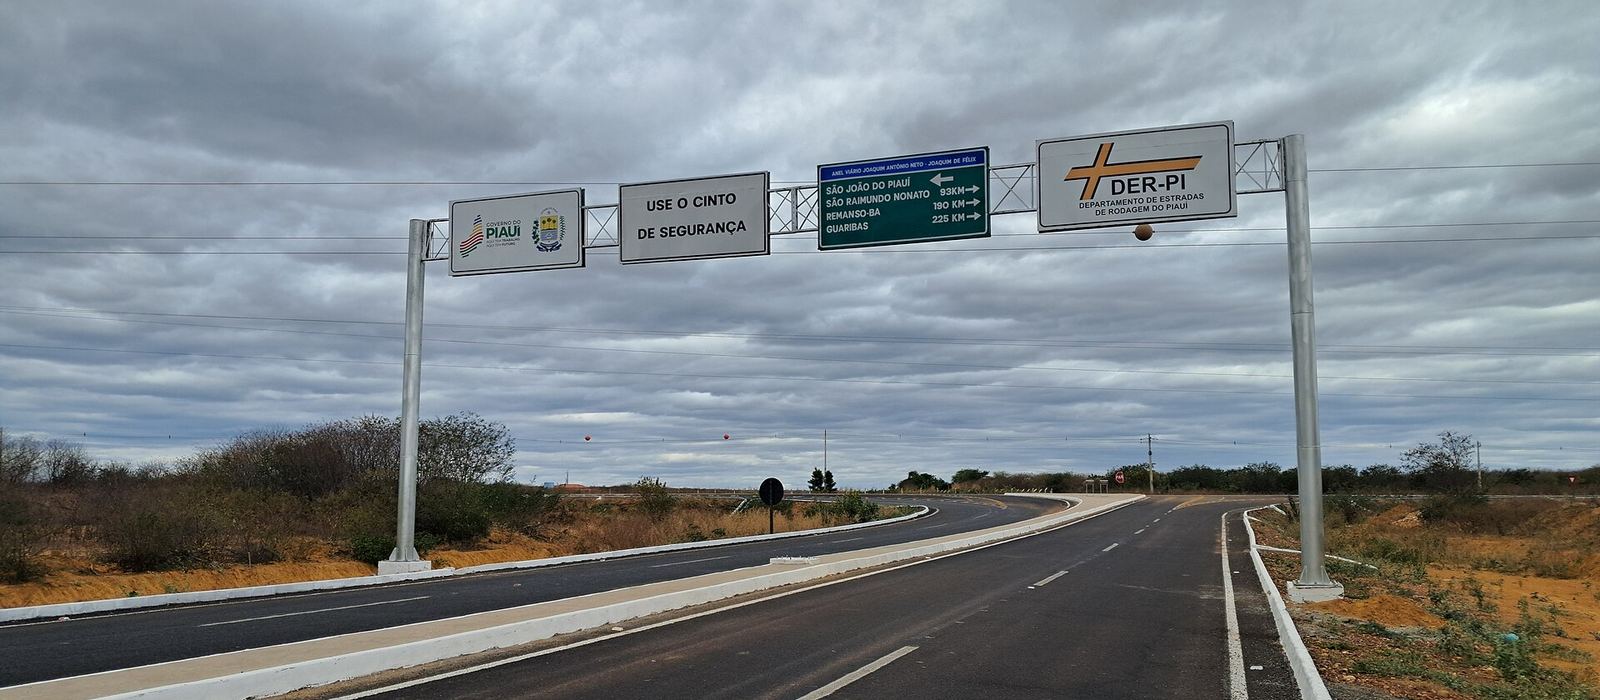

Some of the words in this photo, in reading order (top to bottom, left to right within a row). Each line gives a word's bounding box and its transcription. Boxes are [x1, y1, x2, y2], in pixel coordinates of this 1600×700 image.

[826, 184, 843, 195] SÃO
[846, 180, 870, 193] JOÃO
[872, 181, 885, 190] DO
[888, 177, 911, 188] PIAUÍ
[940, 186, 965, 196] 93KM
[1111, 174, 1186, 196] DER-PI
[646, 199, 673, 212] USE
[677, 198, 688, 209] O
[693, 193, 736, 208] CINTO
[826, 197, 843, 208] SÃO
[846, 192, 891, 206] RAIMUNDO
[893, 190, 930, 201] NONATO
[933, 201, 949, 210] 190
[952, 199, 965, 209] KM
[1079, 197, 1144, 209] DEPARTAMENTO
[1159, 192, 1205, 203] ESTRADAS
[826, 208, 880, 221] REMANSO-BA
[1108, 205, 1150, 215] RODAGEM
[1166, 201, 1188, 210] PIAUÍ
[932, 215, 949, 224] 225
[952, 213, 965, 222] KM
[486, 225, 520, 239] PIAUÍ
[637, 228, 655, 240] DE
[660, 220, 747, 238] SEGURANÇA
[826, 222, 869, 234] GUARIBAS
